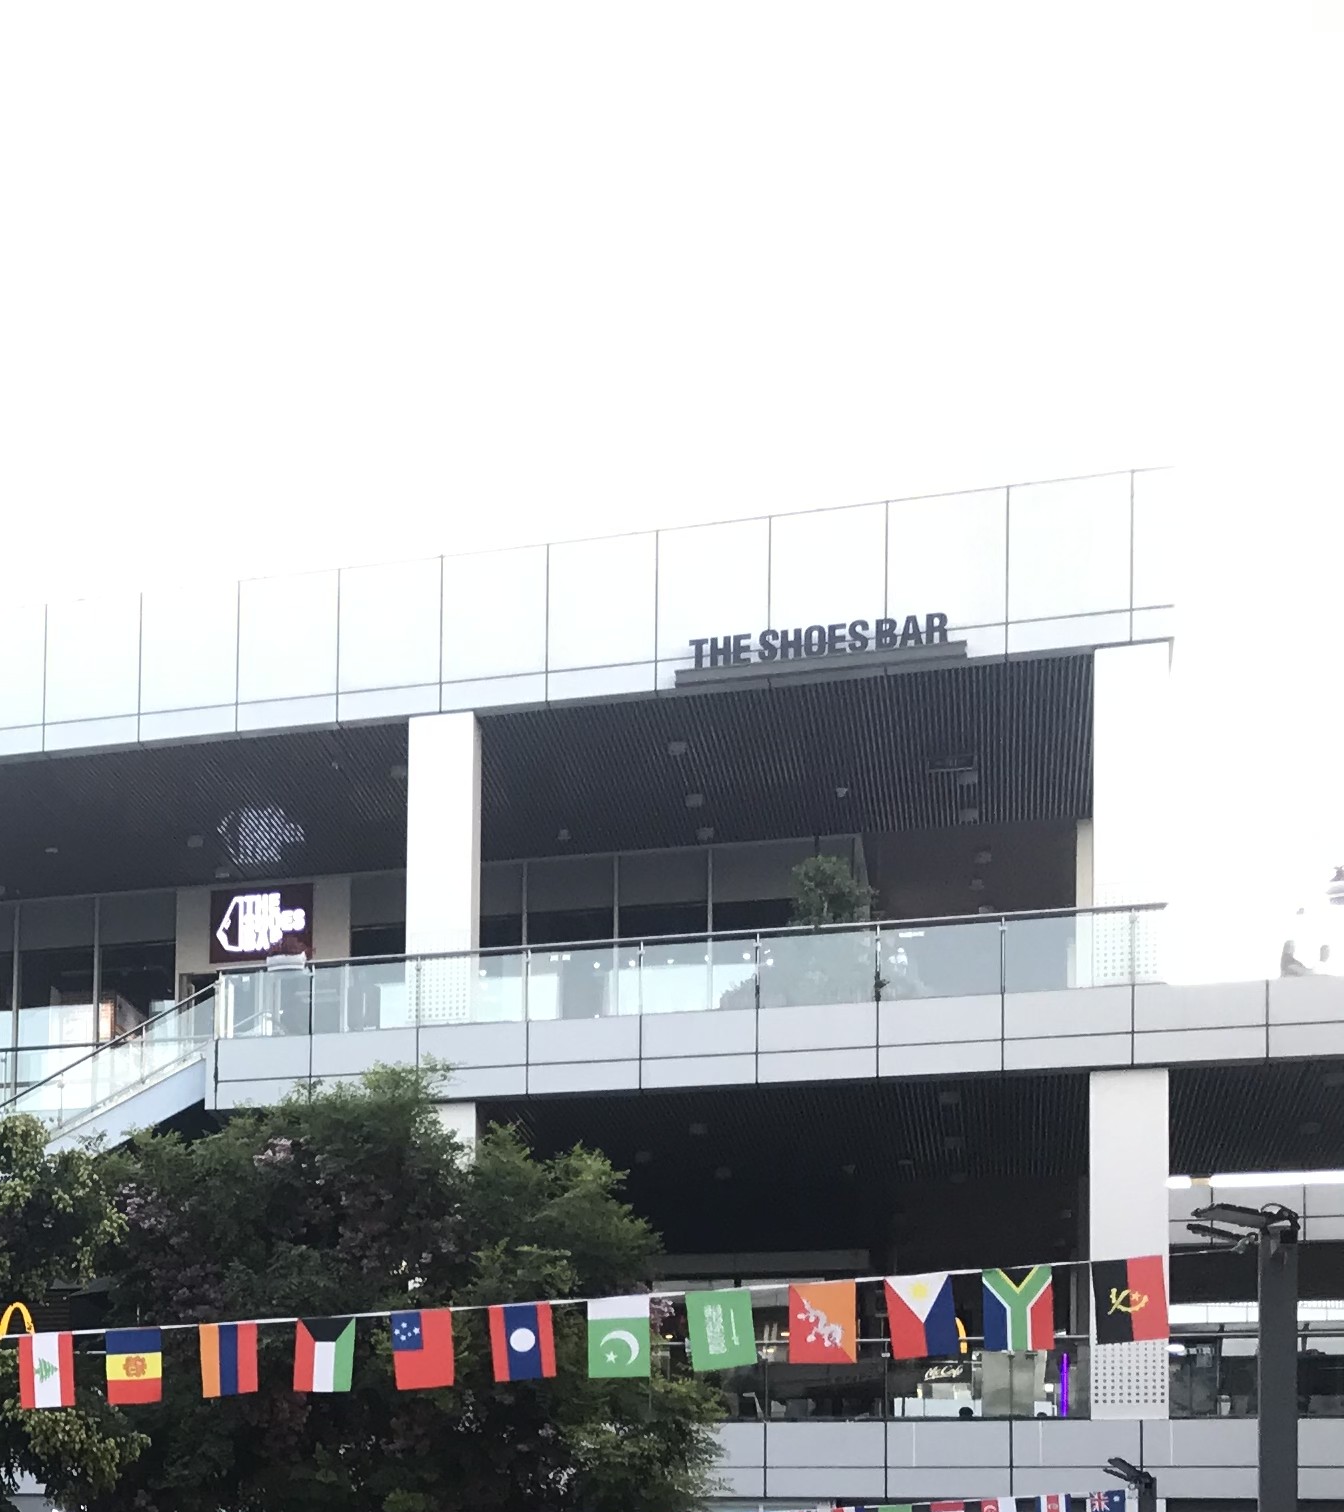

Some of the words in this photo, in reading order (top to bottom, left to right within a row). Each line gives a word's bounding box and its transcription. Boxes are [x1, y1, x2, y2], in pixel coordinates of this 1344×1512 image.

[690, 633, 752, 668] THE
[758, 620, 869, 662] SHOES
[875, 612, 948, 651] BAR
